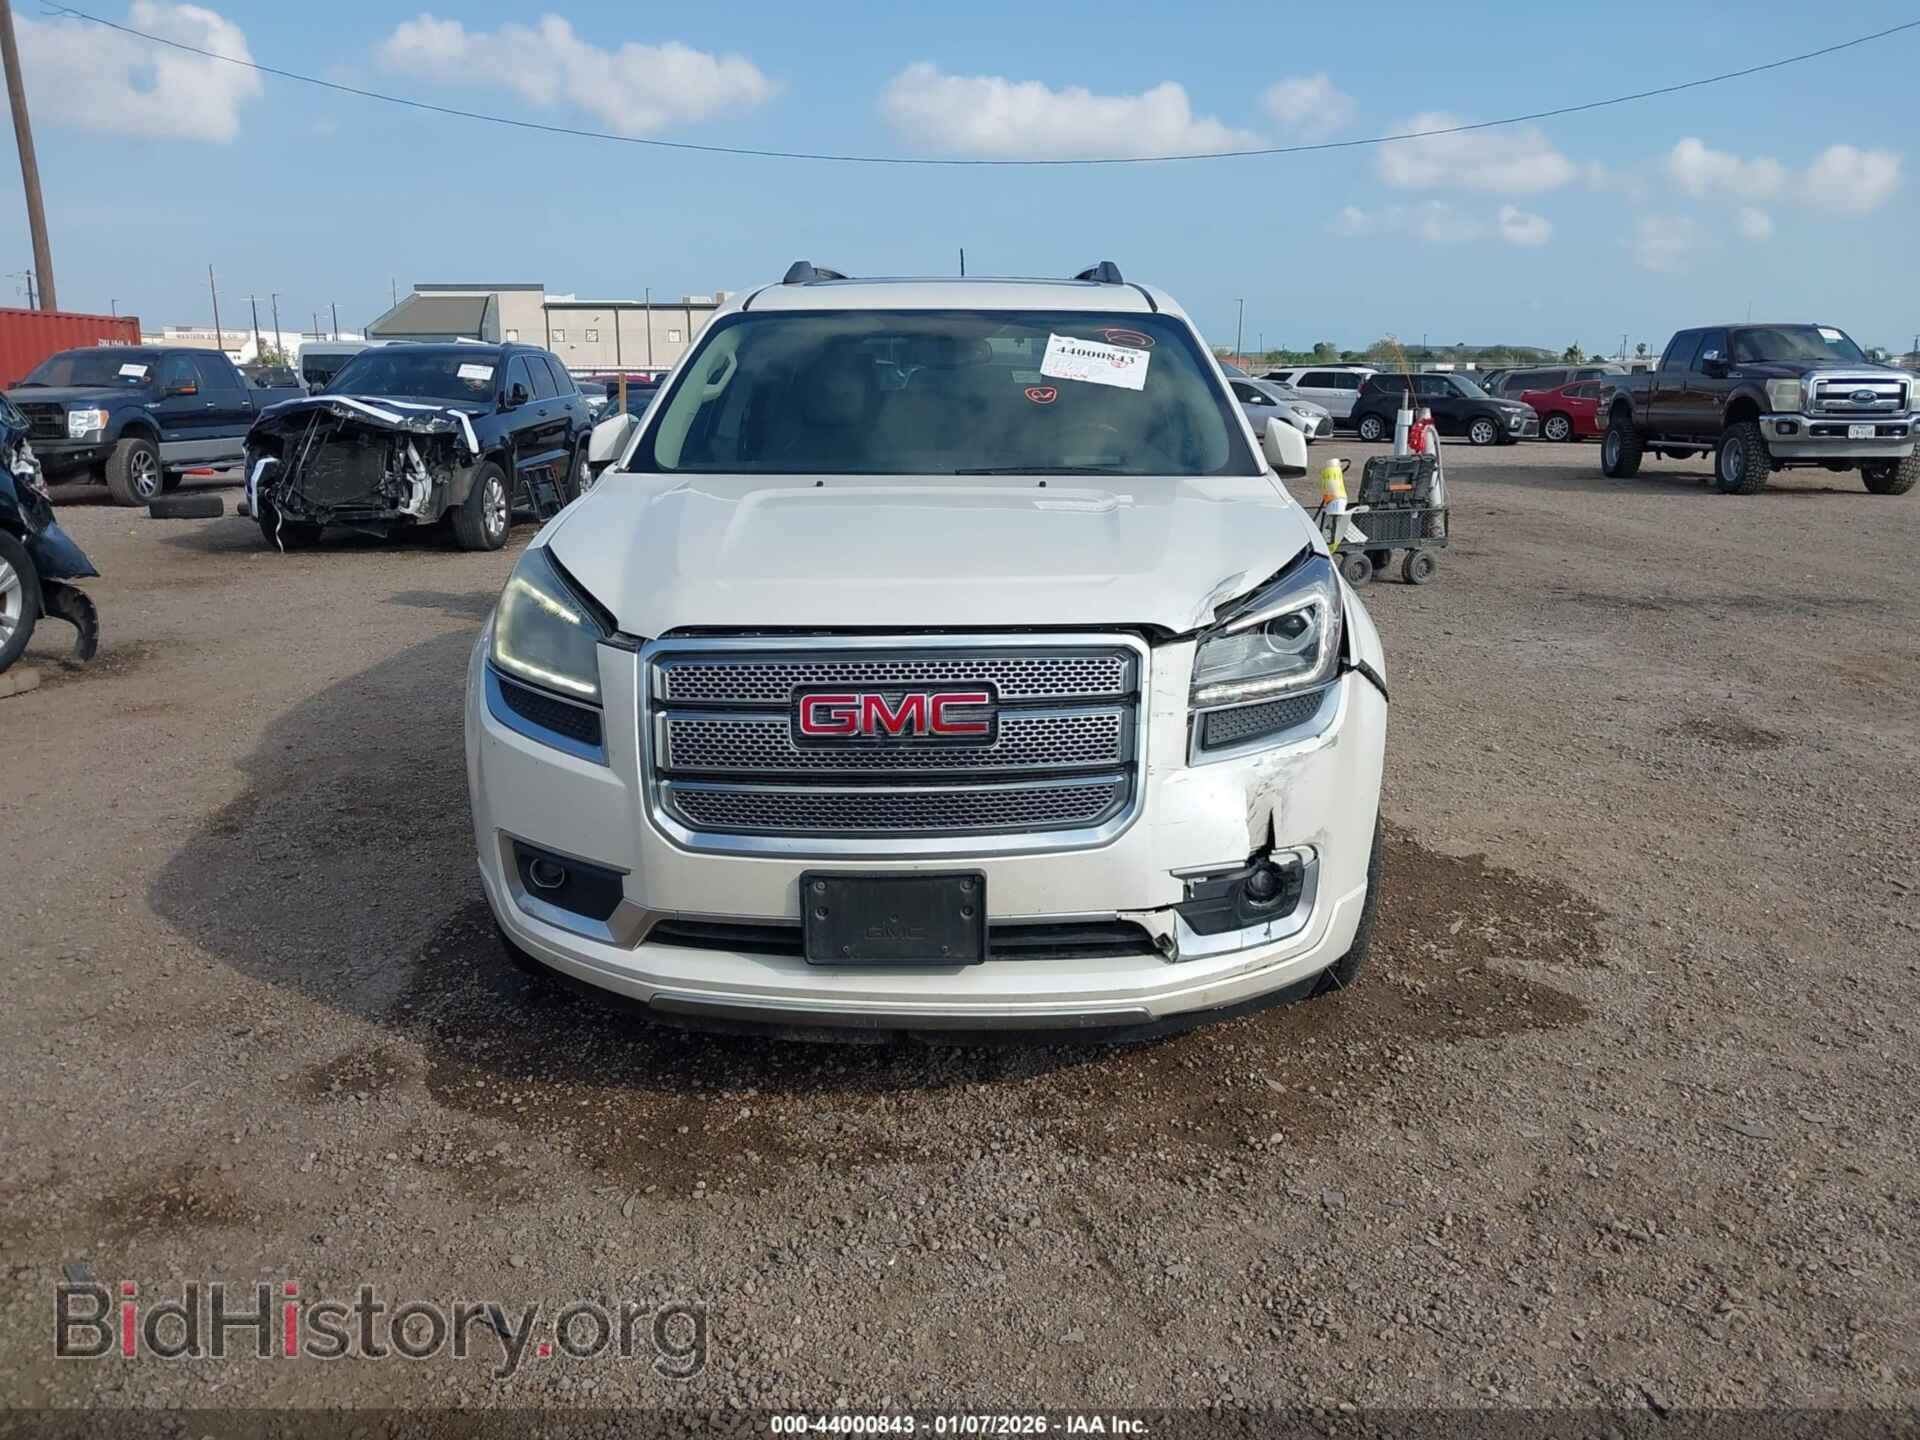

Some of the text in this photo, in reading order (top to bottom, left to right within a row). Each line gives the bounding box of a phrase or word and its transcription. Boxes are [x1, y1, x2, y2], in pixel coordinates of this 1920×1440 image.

[1057, 346, 1136, 365] 44000843
[800, 693, 990, 737] GMC
[865, 926, 929, 941] GMC
